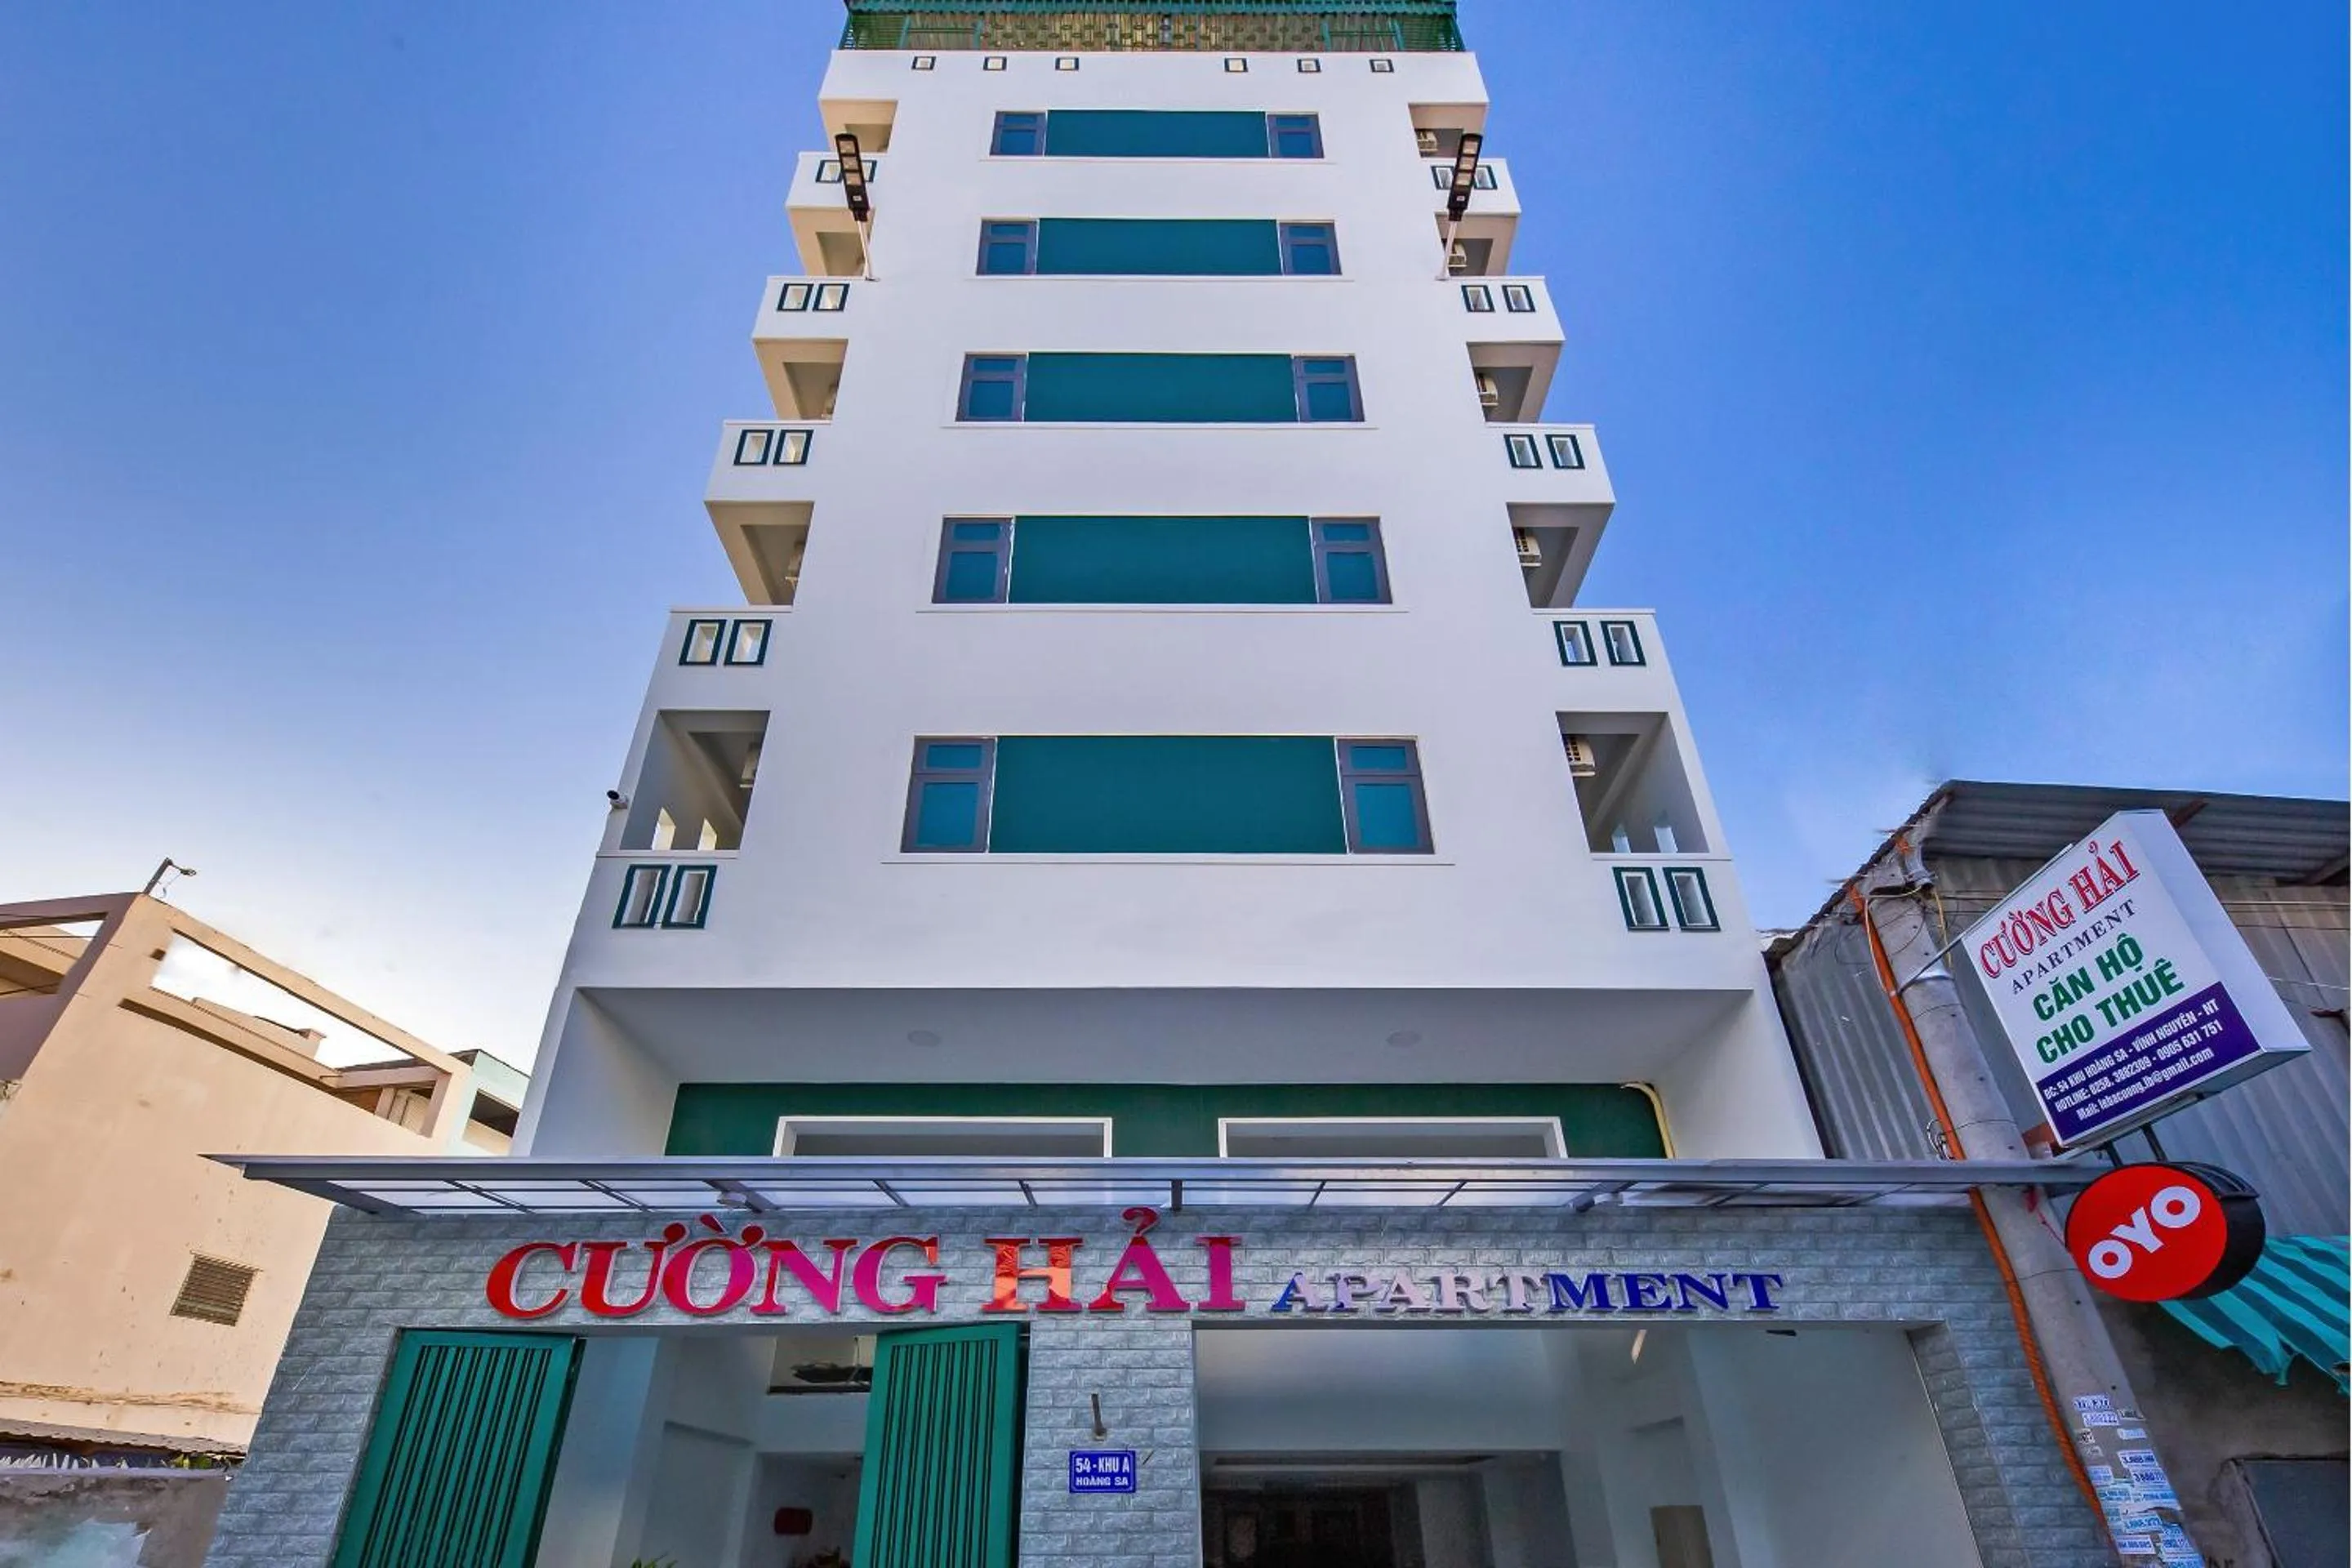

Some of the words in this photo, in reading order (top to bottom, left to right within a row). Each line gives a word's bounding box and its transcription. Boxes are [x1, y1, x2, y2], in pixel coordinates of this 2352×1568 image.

[1980, 888, 2076, 979] CƯỜNG
[2068, 840, 2140, 915] HẢI
[2011, 898, 2136, 995] APARTMENT
[2033, 966, 2096, 1021] CĂN
[2095, 933, 2143, 982] HỘ
[2036, 1014, 2095, 1063] CHO
[2095, 958, 2185, 1027] THUÊ
[2067, 1070, 2086, 1087] KHU
[2114, 1048, 2129, 1062] SA
[2202, 998, 2219, 1015] NT
[2156, 1040, 2183, 1060] 0905
[2180, 1030, 2203, 1048] 631
[2200, 1019, 2223, 1037] 751
[485, 1213, 950, 1321] CƯỜNG
[981, 1207, 1245, 1315] HẢI
[1272, 1272, 1784, 1315] APARTMENT
[2087, 1185, 2201, 1279] OYO
[1075, 1457, 1091, 1473] 54
[1098, 1456, 1120, 1473] KHU
[1122, 1456, 1130, 1473] A
[1076, 1475, 1111, 1486] HOÀNG
[1114, 1477, 1129, 1486] SA
